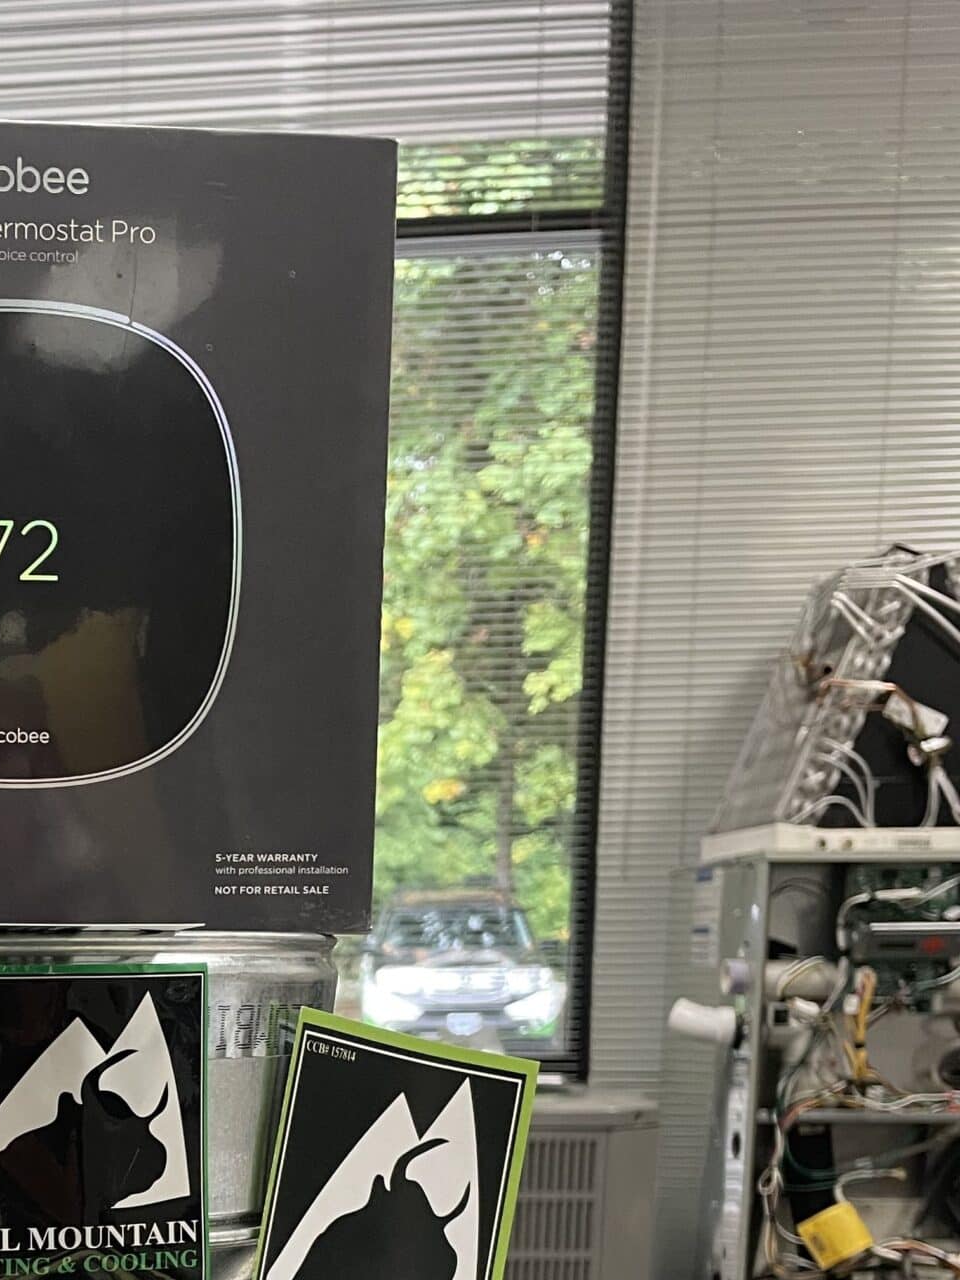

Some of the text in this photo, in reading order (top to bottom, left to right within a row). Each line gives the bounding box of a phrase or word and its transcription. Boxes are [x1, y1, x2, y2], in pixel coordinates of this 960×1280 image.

[111, 219, 157, 244] Pro
[29, 250, 79, 264] control
[215, 853, 319, 863] 5-YEAR WARRANTY
[215, 865, 349, 876] with professional installation
[214, 885, 330, 895] NOT FOR RETAIL SALE
[28, 1219, 200, 1251] MOUNTAIN
[56, 1256, 76, 1275] &
[82, 1249, 199, 1274] COOLING
